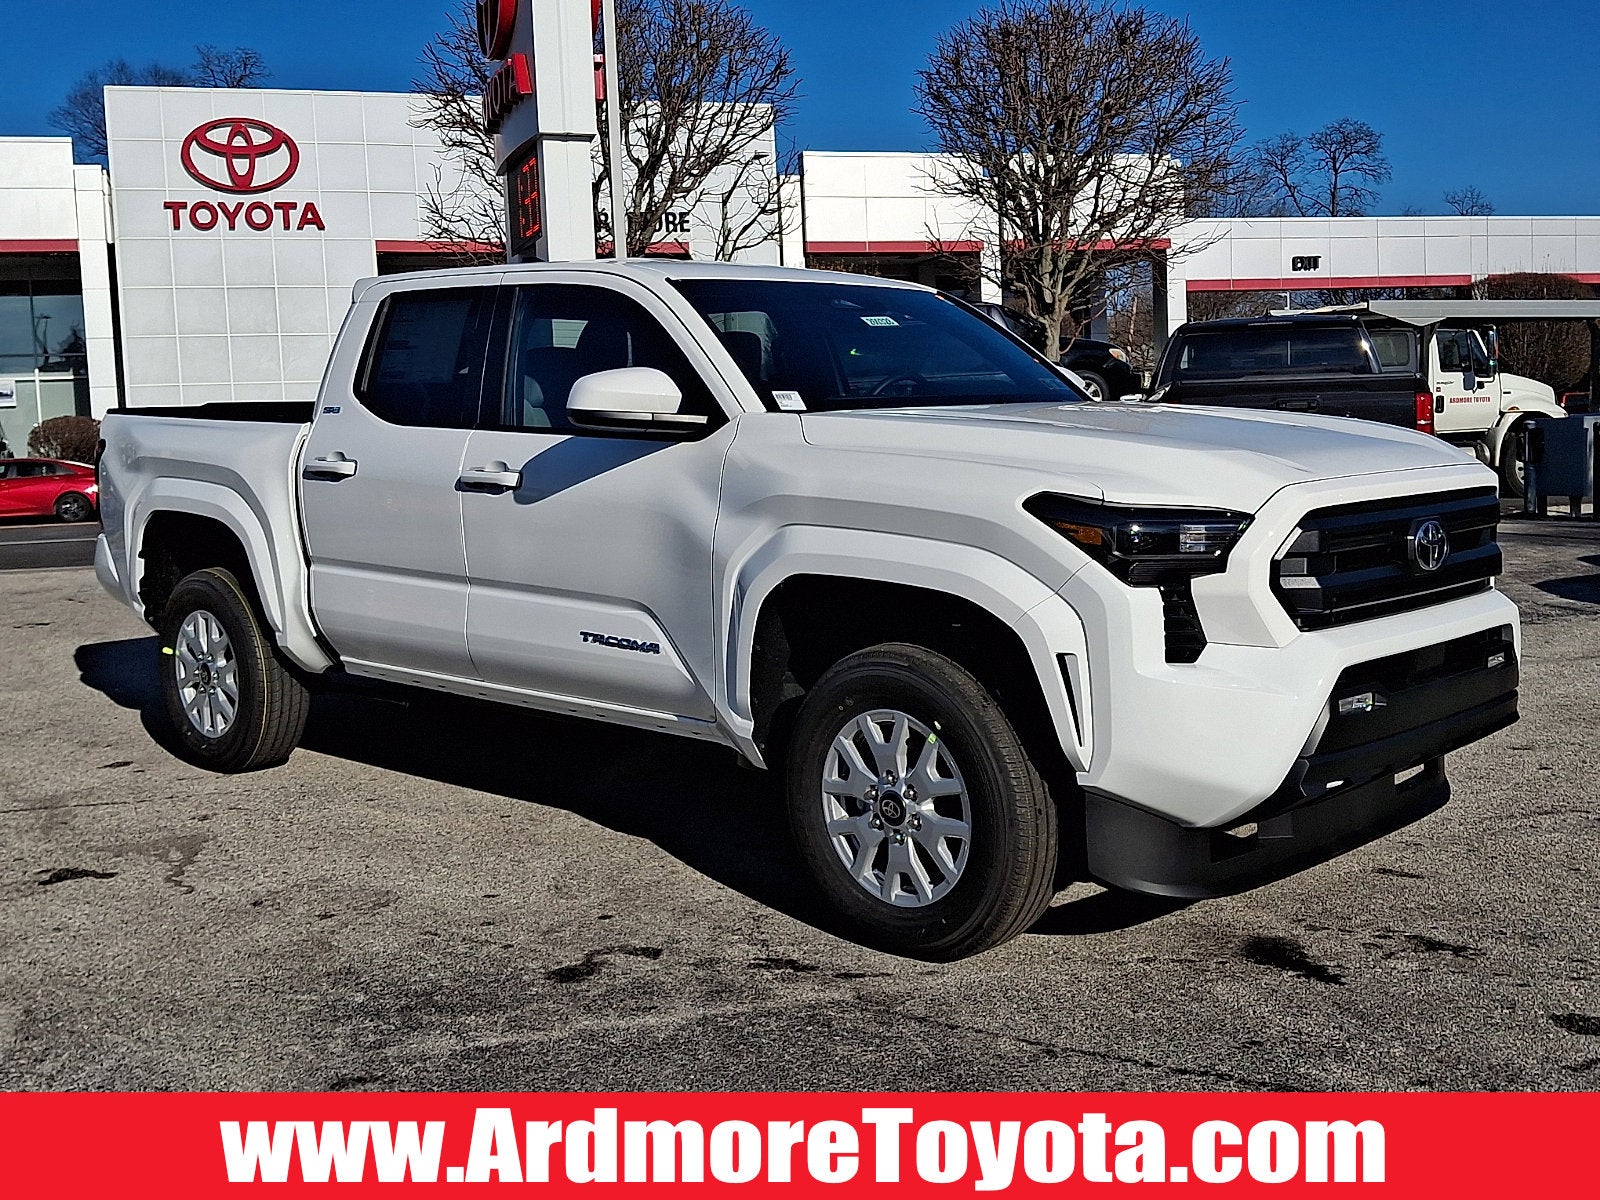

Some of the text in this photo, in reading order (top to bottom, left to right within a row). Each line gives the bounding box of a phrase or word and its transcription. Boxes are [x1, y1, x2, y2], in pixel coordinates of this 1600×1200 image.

[163, 201, 325, 231] TOYOTA
[1291, 256, 1322, 271] EXIT
[580, 631, 661, 654] TACOMA
